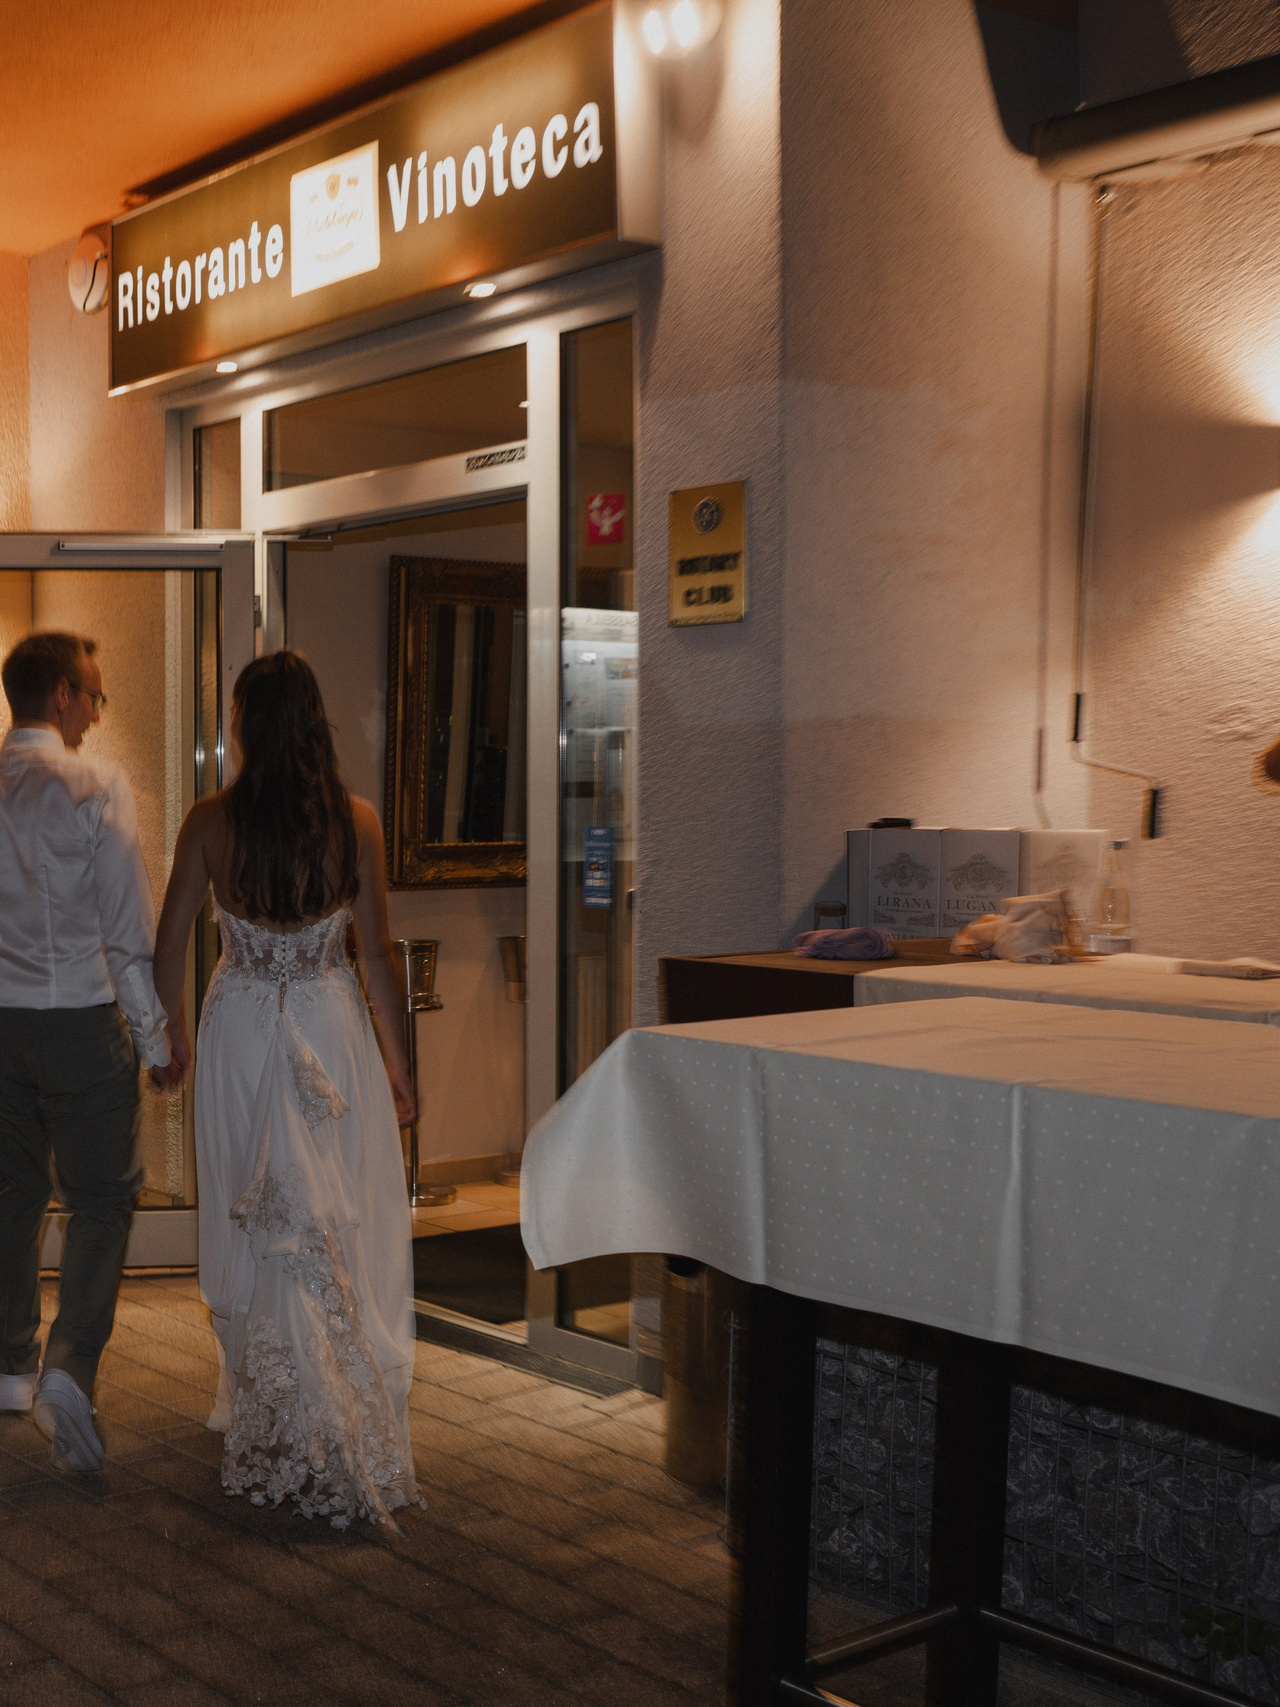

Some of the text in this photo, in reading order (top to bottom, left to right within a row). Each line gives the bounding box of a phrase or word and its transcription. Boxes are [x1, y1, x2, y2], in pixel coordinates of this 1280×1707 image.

[386, 101, 604, 233] Vinoteca
[118, 220, 284, 332] Ristorante
[683, 584, 734, 607] CLUB
[877, 895, 932, 909] LIRANA
[946, 899, 998, 912] LUGAN
